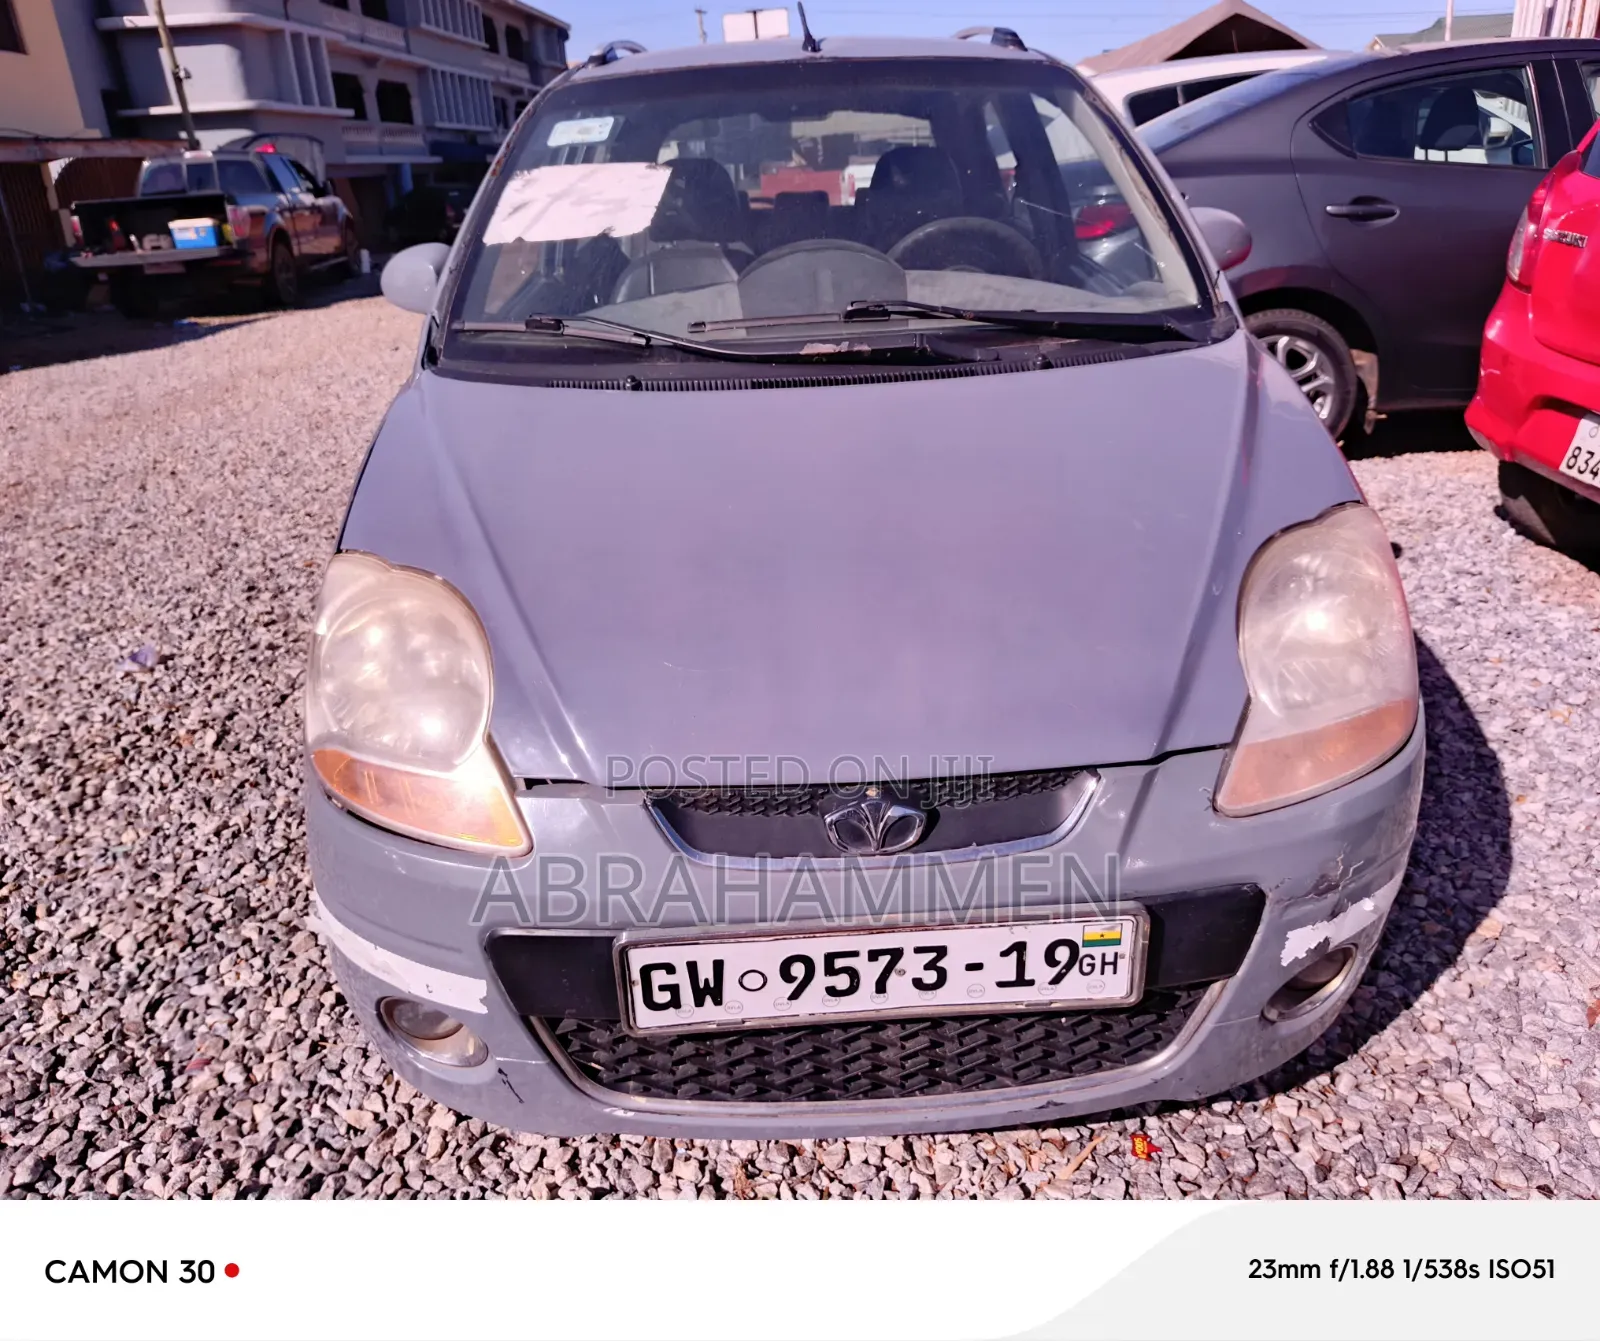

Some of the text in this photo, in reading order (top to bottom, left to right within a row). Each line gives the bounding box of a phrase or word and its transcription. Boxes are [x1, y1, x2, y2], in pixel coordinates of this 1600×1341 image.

[1543, 228, 1588, 248] SUZUKI
[1079, 951, 1118, 976] GH
[639, 959, 724, 1011] GW
